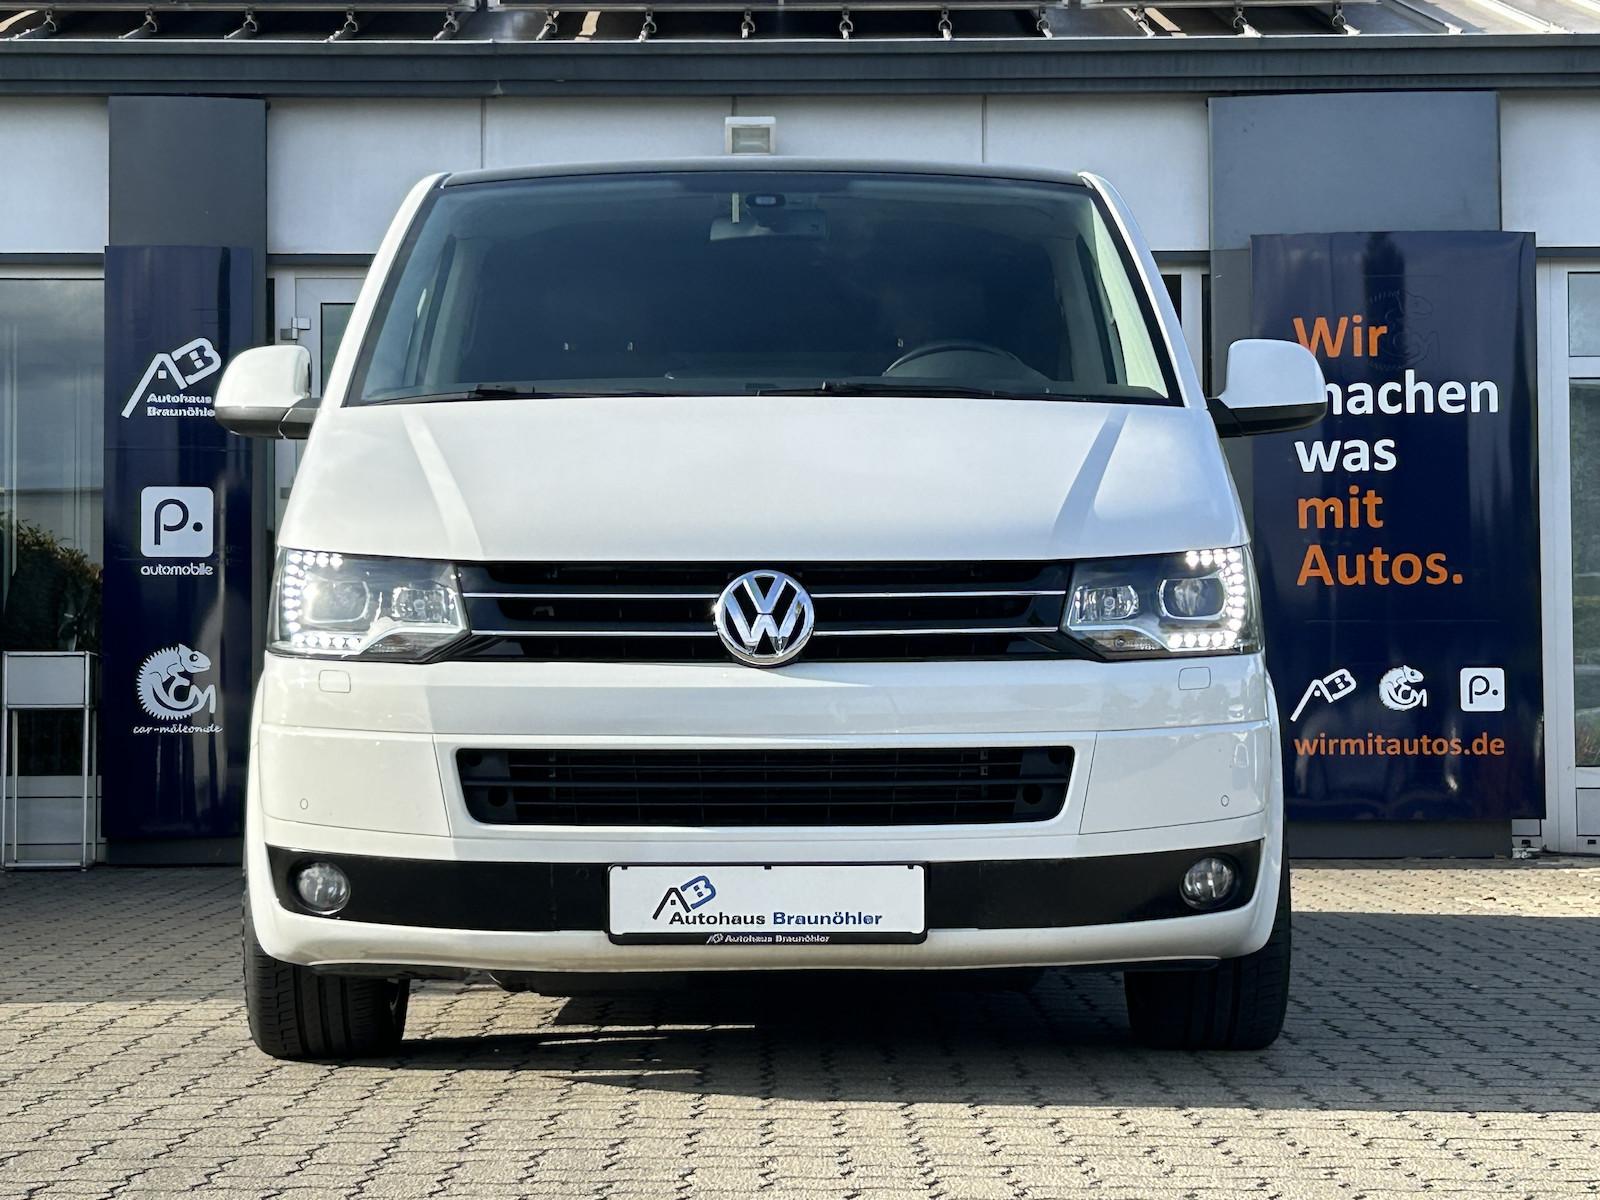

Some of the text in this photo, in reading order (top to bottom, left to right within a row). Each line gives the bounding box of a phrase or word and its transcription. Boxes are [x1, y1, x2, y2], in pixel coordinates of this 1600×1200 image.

[1293, 315, 1388, 358] Wir
[121, 337, 222, 419] AB
[146, 393, 212, 404] Autohaus
[146, 406, 216, 417] Braunöhle
[1294, 438, 1397, 473] was
[1297, 485, 1384, 529] mit
[140, 563, 214, 576] automobile
[1296, 544, 1463, 586] Autos.
[721, 572, 807, 659] VW
[1290, 668, 1357, 722] AB
[1294, 732, 1505, 756] wirmitautos.de
[653, 875, 717, 920] AB
[669, 910, 883, 926] Autohaus Braunöhler
[724, 935, 773, 943] Autohaus
[775, 934, 830, 943] Braunöhler
